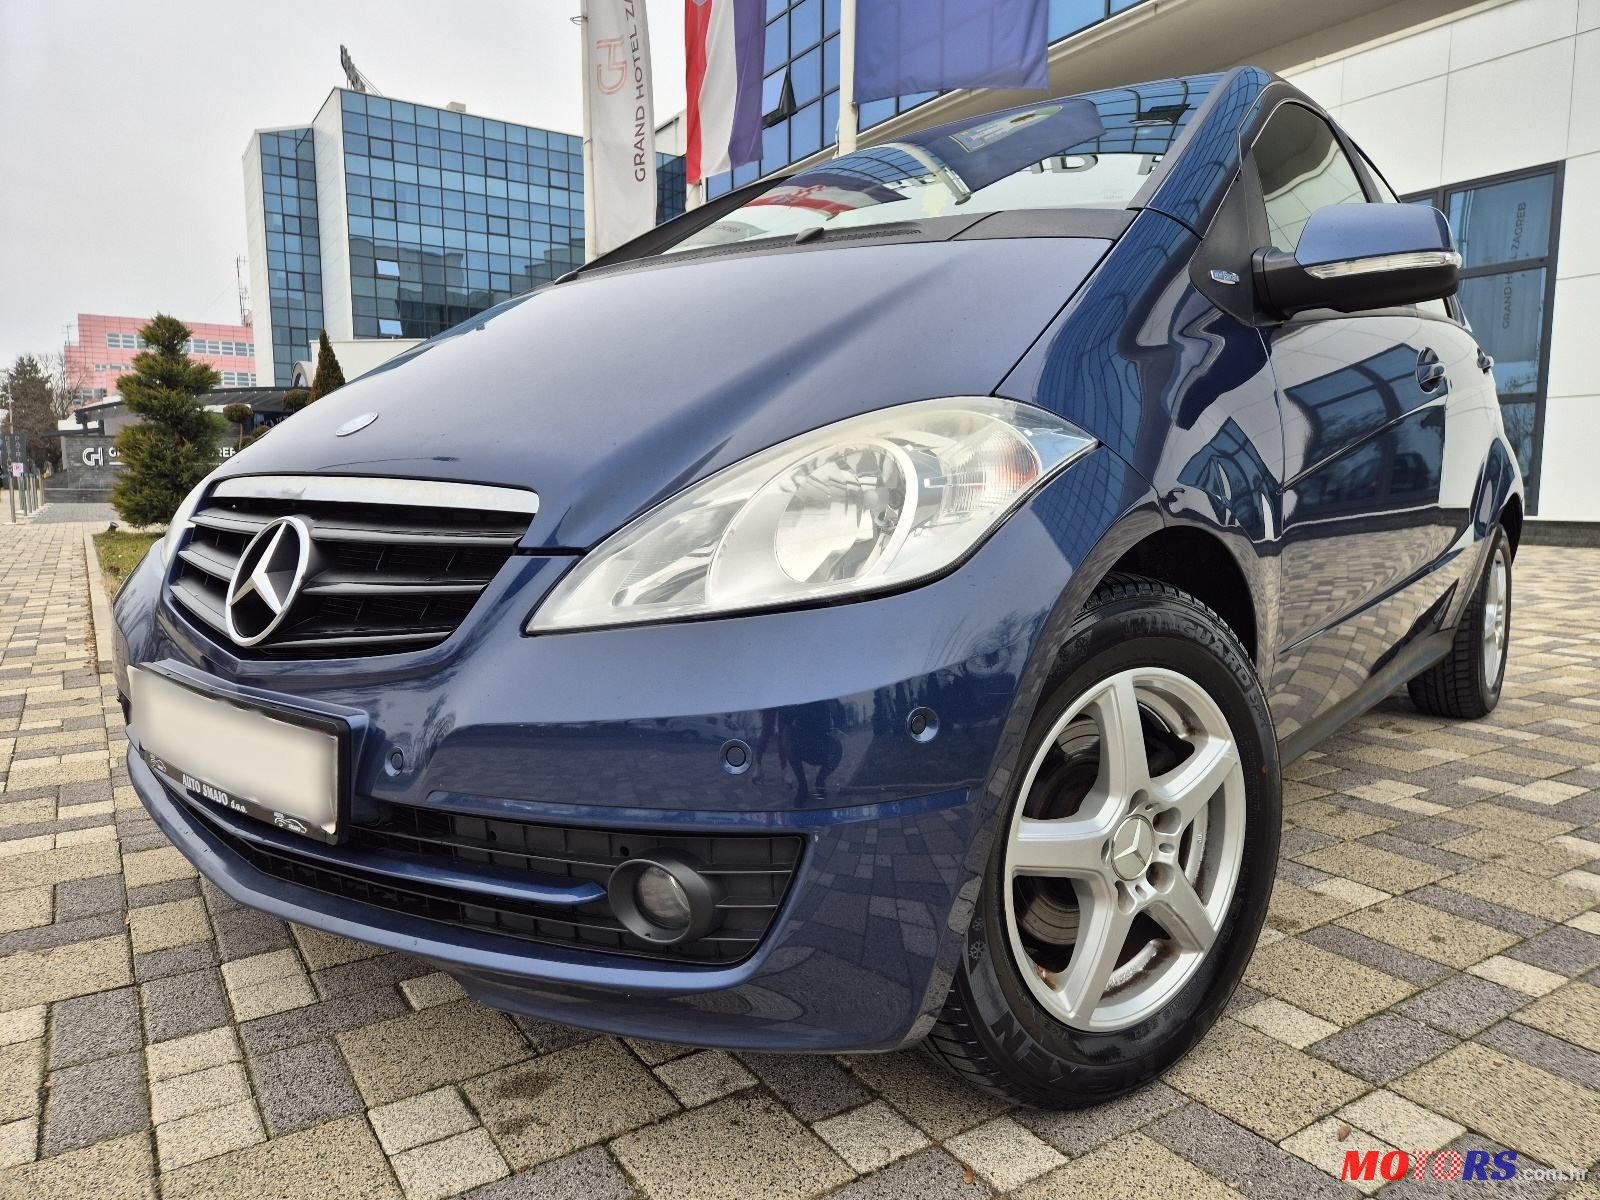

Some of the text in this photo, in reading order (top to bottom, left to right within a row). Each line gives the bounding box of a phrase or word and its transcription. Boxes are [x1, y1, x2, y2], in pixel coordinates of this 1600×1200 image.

[630, 24, 645, 100] HOTEL
[634, 105, 646, 182] GRAND
[182, 773, 201, 793] AUTO
